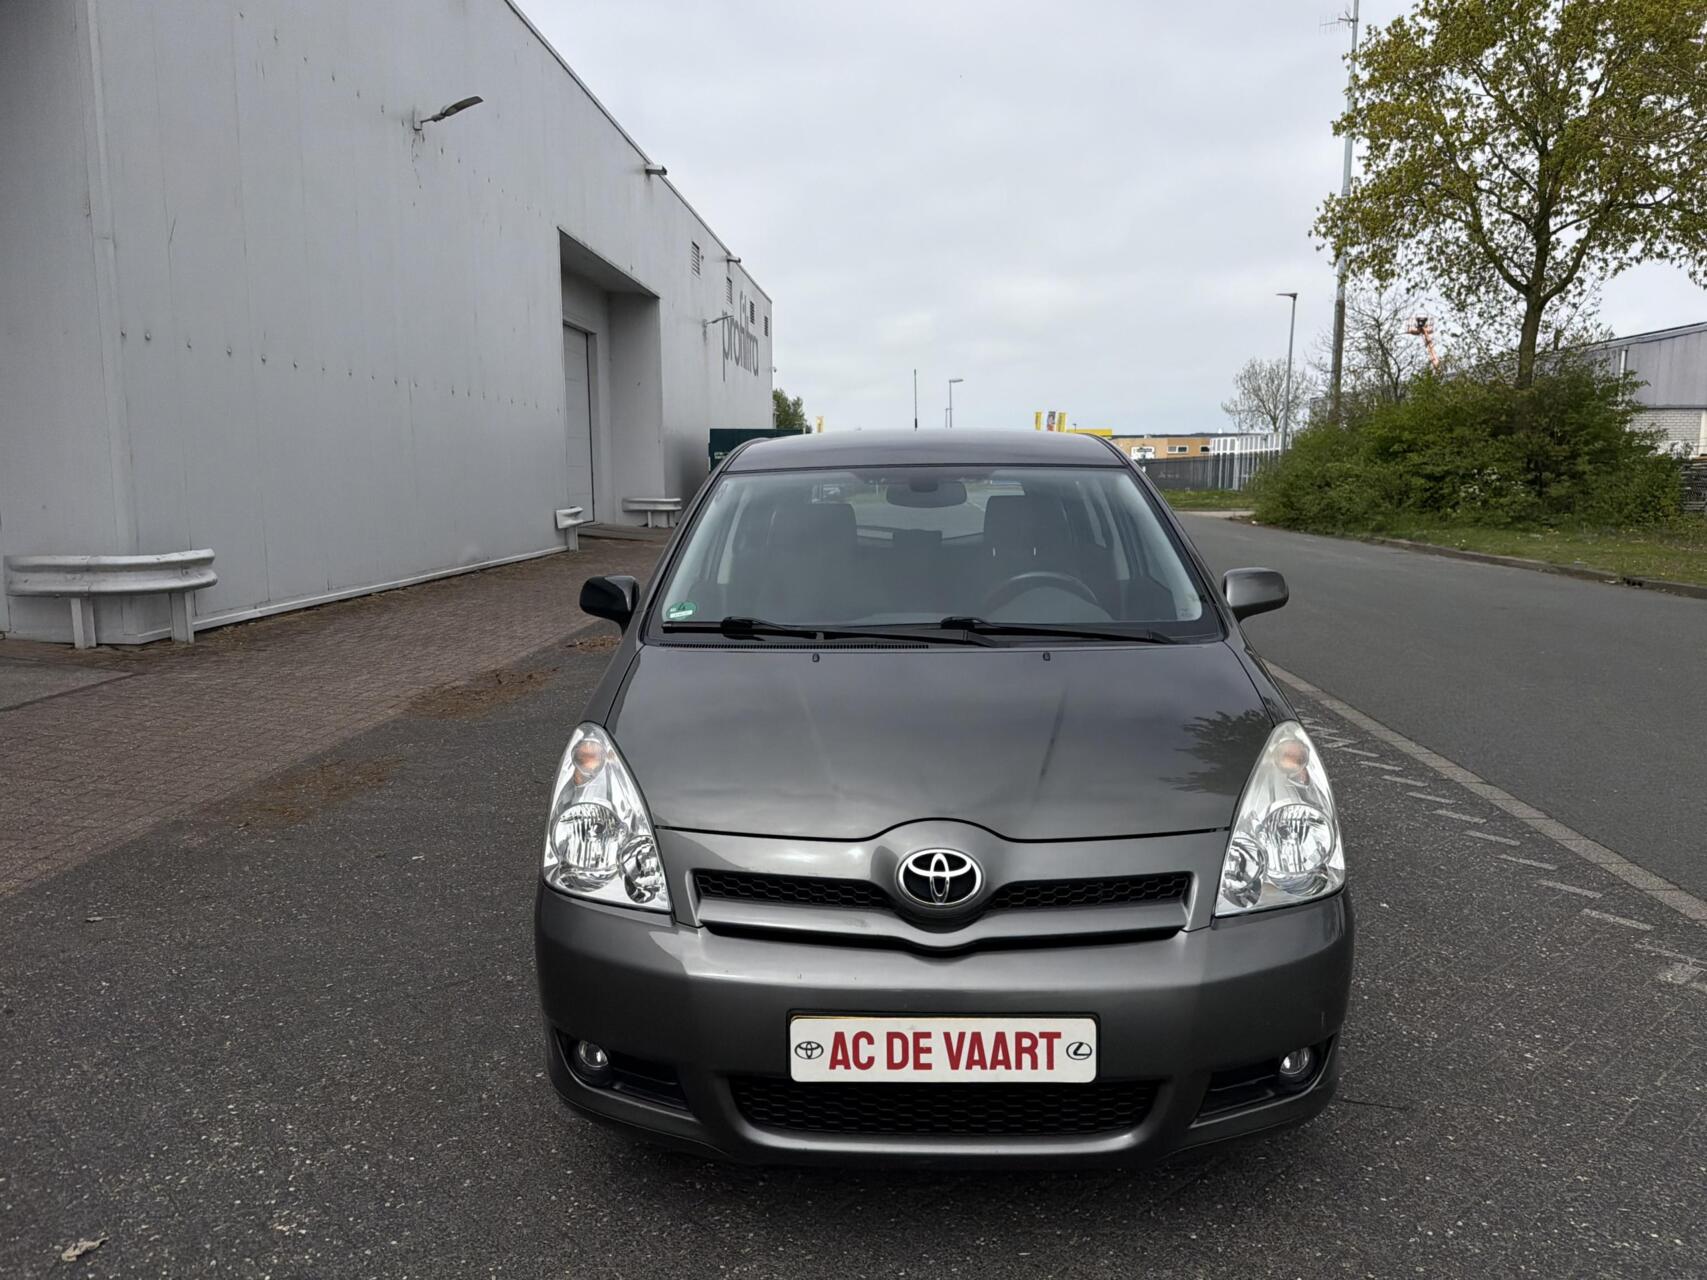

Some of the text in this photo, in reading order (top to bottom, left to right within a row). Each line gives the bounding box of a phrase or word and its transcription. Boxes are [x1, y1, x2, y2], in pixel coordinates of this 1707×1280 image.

[829, 1031, 1062, 1070] AC DE VAART
